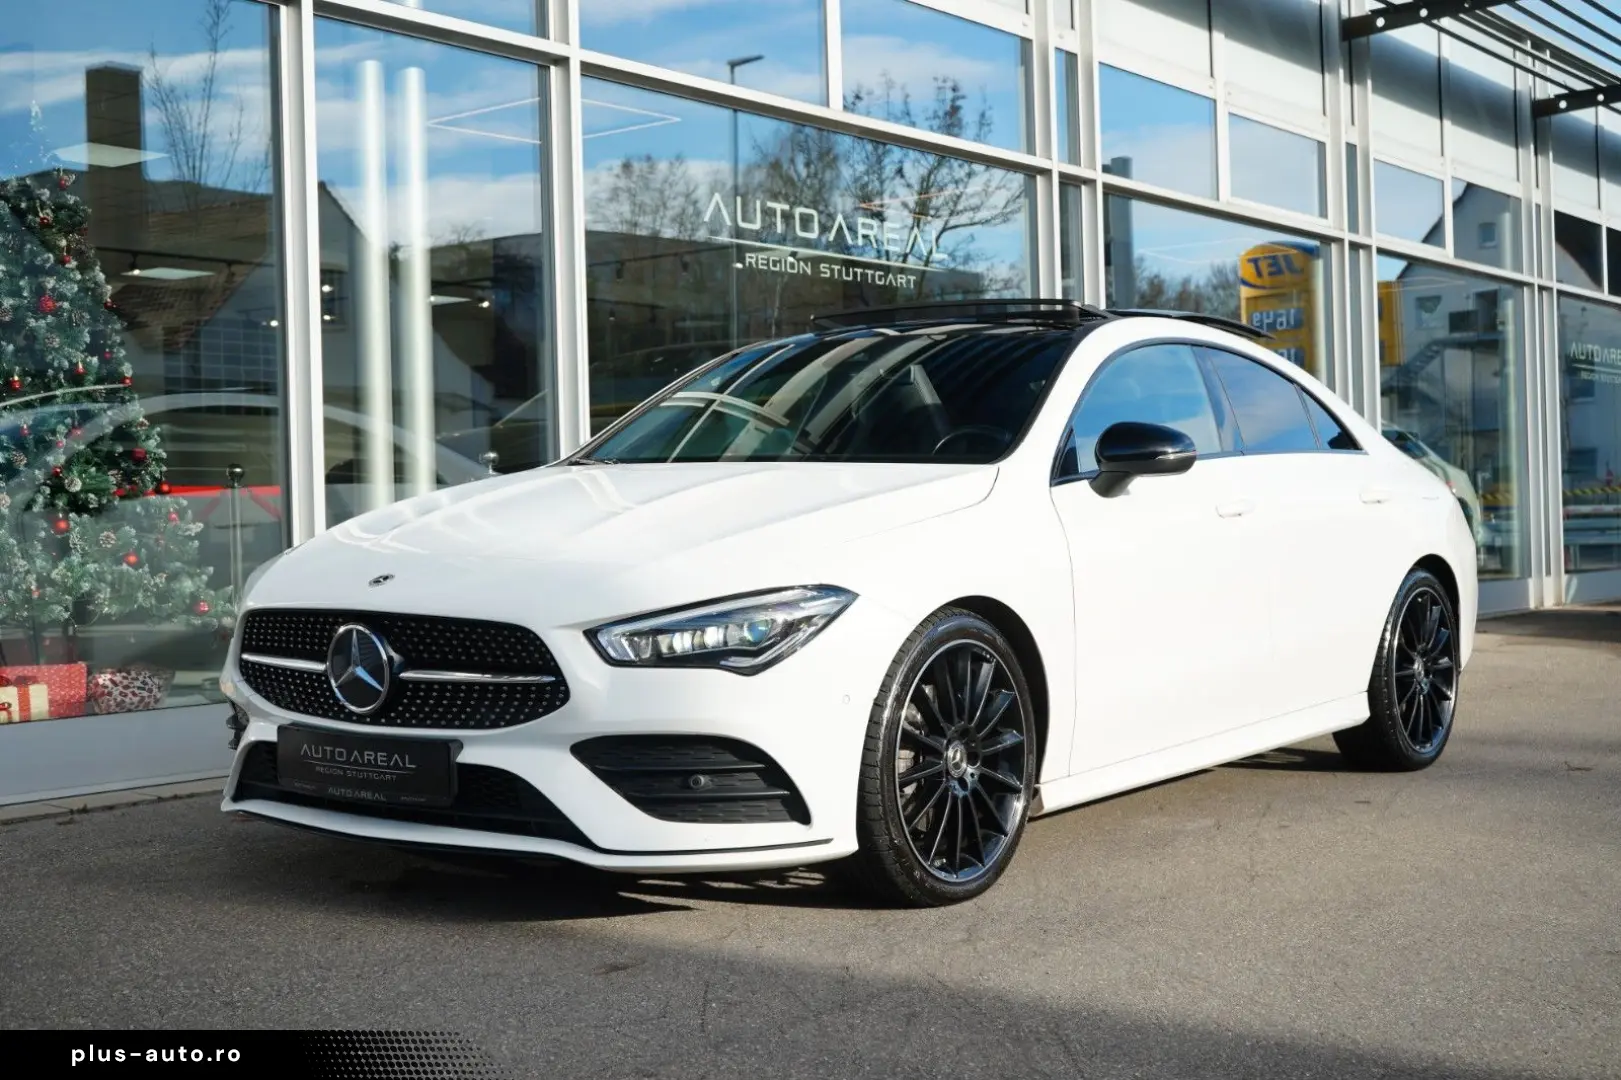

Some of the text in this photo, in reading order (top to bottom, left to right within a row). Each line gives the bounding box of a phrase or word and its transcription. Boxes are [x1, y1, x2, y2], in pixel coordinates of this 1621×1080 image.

[703, 191, 948, 260] AUTOAREAL
[745, 252, 916, 289] REGION STUTTGART
[300, 743, 417, 768] AUTOAREAL
[315, 766, 397, 782] REGION STUTTGART
